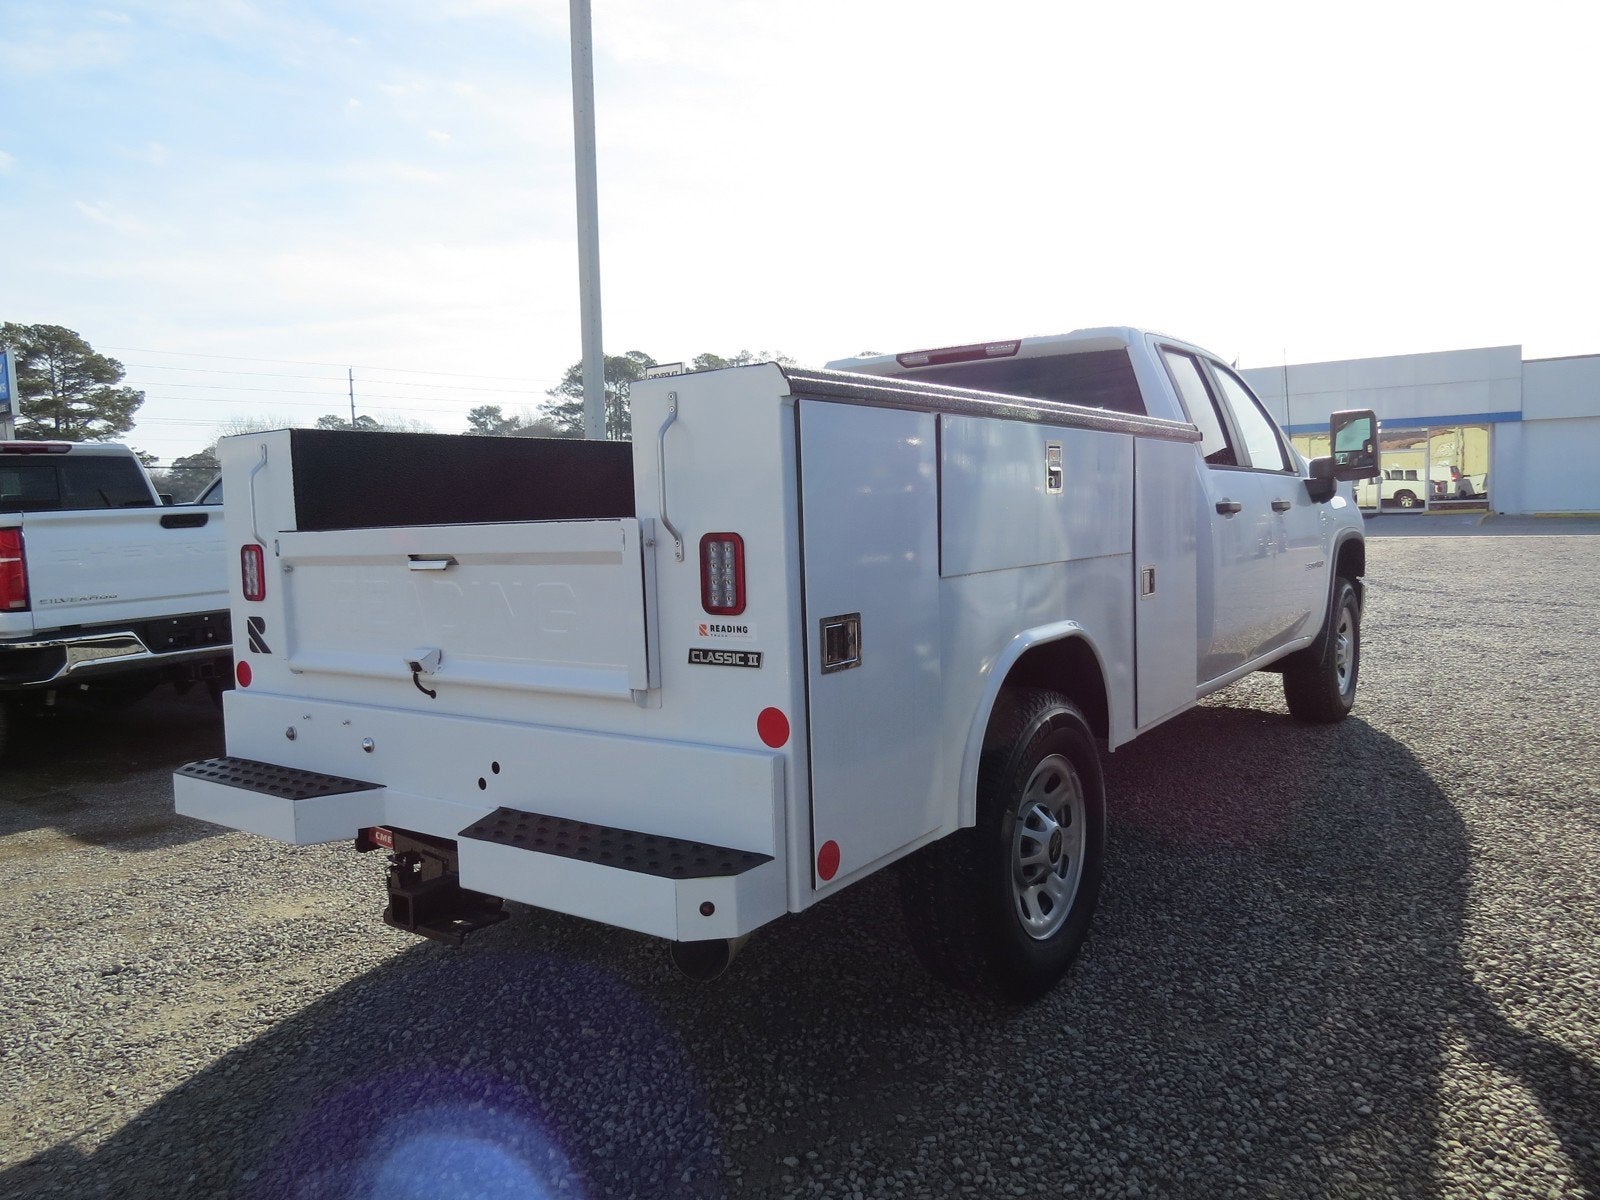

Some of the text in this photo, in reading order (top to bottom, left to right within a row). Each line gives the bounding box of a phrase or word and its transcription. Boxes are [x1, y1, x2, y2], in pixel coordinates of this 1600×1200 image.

[710, 624, 748, 634] READING
[691, 650, 759, 666] CLASSIC II
